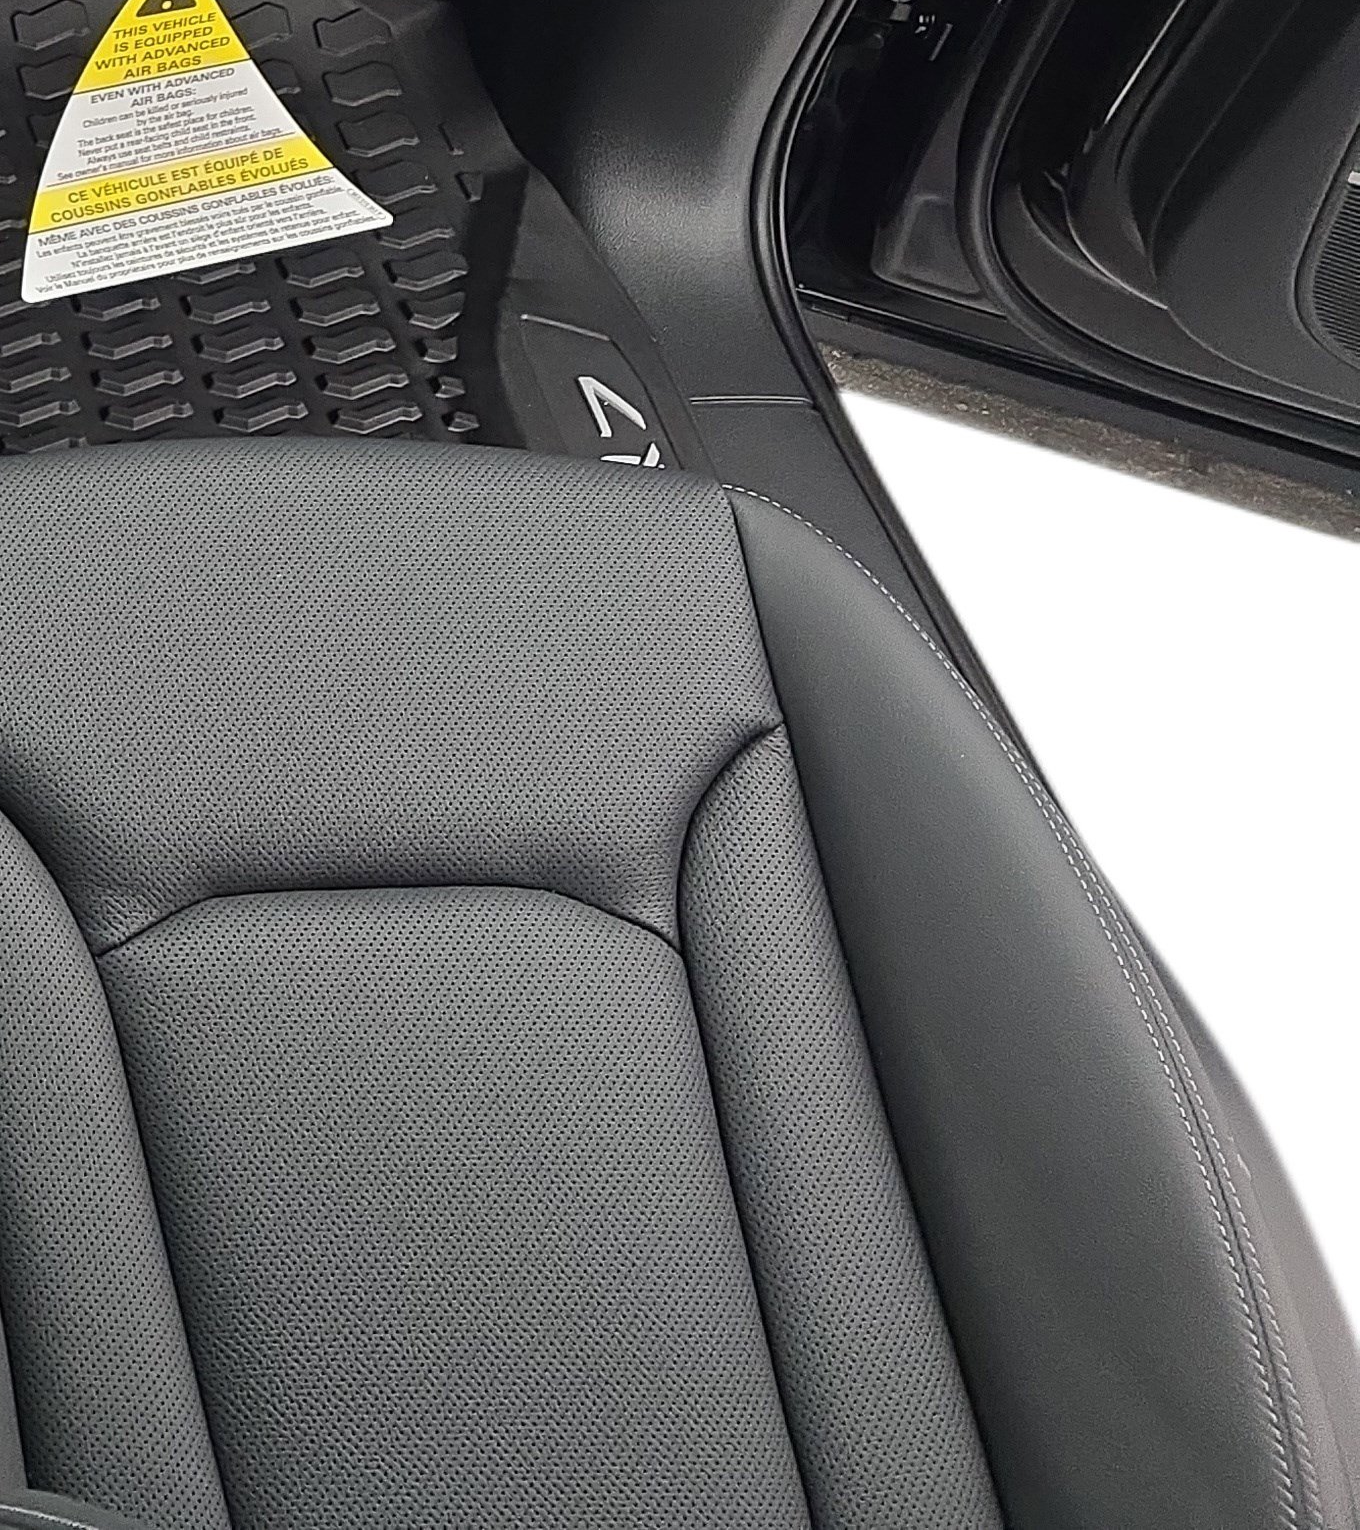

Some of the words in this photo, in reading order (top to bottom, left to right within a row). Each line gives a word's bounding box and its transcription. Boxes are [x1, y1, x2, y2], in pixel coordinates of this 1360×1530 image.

[113, 24, 147, 40] THIS
[152, 12, 216, 32] VEHICLE
[114, 41, 128, 52] IS
[134, 26, 213, 49] EQUIPPED
[95, 53, 137, 70] WITH
[142, 36, 230, 61] ADVANCED
[123, 65, 151, 78] AIR
[157, 55, 201, 72] BAGS
[90, 89, 123, 104] EVEN
[127, 82, 160, 96] WITH
[164, 66, 235, 89] ADVANCED
[131, 95, 153, 107] AIR
[157, 86, 196, 102] BAGS:
[51, 196, 130, 223] COUSSINS
[135, 173, 236, 205] GONFLABLES
[240, 155, 309, 182] ÉVOLUÉS
[68, 189, 88, 203] CE
[91, 169, 167, 198] VÉHICULE
[170, 165, 199, 181] EST
[204, 150, 258, 173] ÉQUIPÉ
[263, 147, 283, 161] DE
[37, 229, 77, 247] MÊME
[80, 223, 111, 238] AVEC
[112, 217, 136, 230] DES
[138, 204, 199, 225] COUSSINS
[202, 187, 276, 211] GONFLABLES
